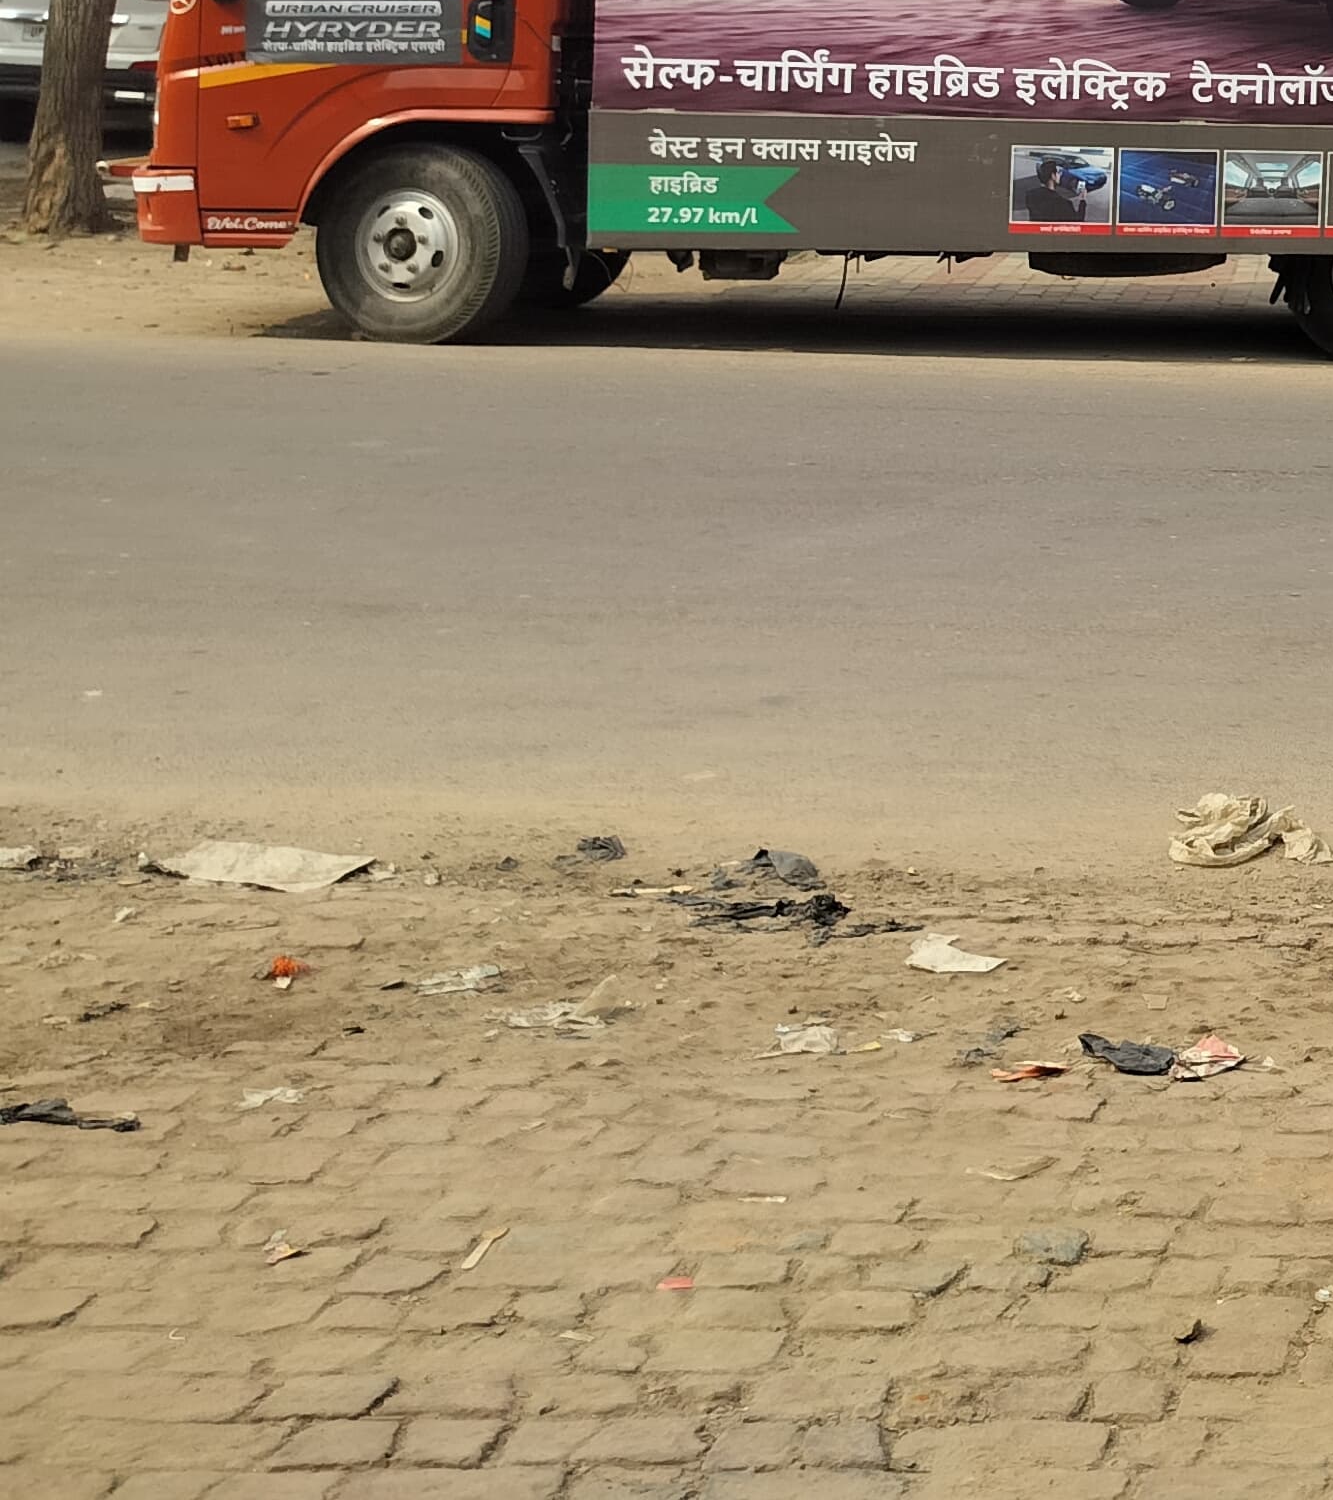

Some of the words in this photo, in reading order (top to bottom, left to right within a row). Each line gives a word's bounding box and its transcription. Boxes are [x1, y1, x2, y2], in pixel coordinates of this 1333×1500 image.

[271, 4, 343, 13] URBAN
[348, 4, 437, 14] CRUISER
[263, 21, 441, 38] HYRYDER
[621, 44, 856, 96] सेल्फ-चार्जिंग
[866, 55, 1004, 104] हाइब्रिड
[1013, 58, 1171, 110] इलेक्ट्रिक
[649, 128, 699, 161] बेस्ट
[708, 137, 745, 164] इन
[751, 138, 820, 162] क्लास
[827, 133, 917, 167] माइलेज
[650, 172, 719, 195] हाइब्रिड
[648, 207, 704, 225] 27.97
[708, 208, 757, 227] km/l
